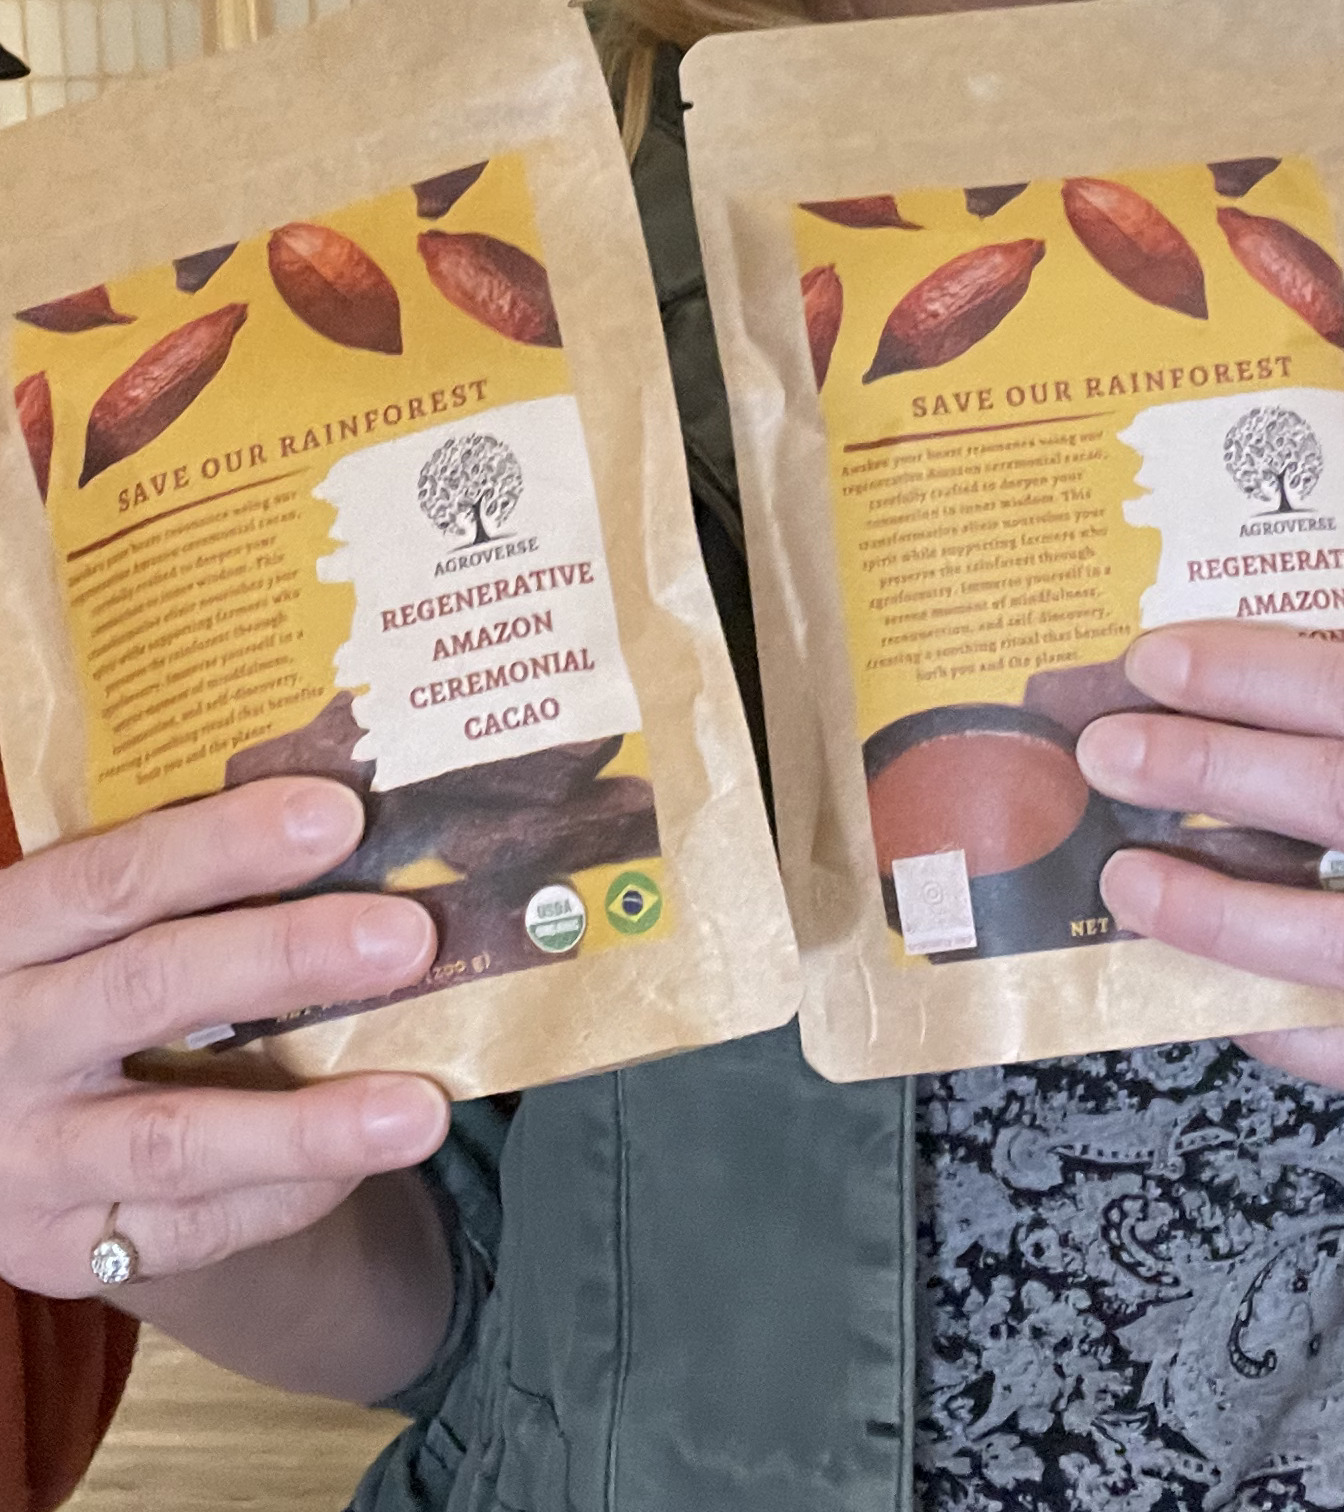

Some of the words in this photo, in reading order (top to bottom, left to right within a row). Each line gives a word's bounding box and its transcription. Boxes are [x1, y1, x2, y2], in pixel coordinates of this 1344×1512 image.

[913, 388, 994, 418] SAVE
[1007, 379, 1072, 407] OUR
[1087, 355, 1293, 399] RAINFOREST
[117, 466, 192, 513] SAVE
[201, 444, 267, 482] OUR
[280, 378, 490, 458] RAINFOREST
[1240, 517, 1336, 538] AGROVERSE
[434, 536, 540, 578] AGROVERSE
[382, 561, 595, 632] REGENERATIVE
[432, 612, 554, 662] AMAZON
[409, 647, 595, 709] CEREMONIAL
[463, 699, 561, 741] CACAO
[536, 898, 573, 919] USDA
[1070, 917, 1109, 937] NET
